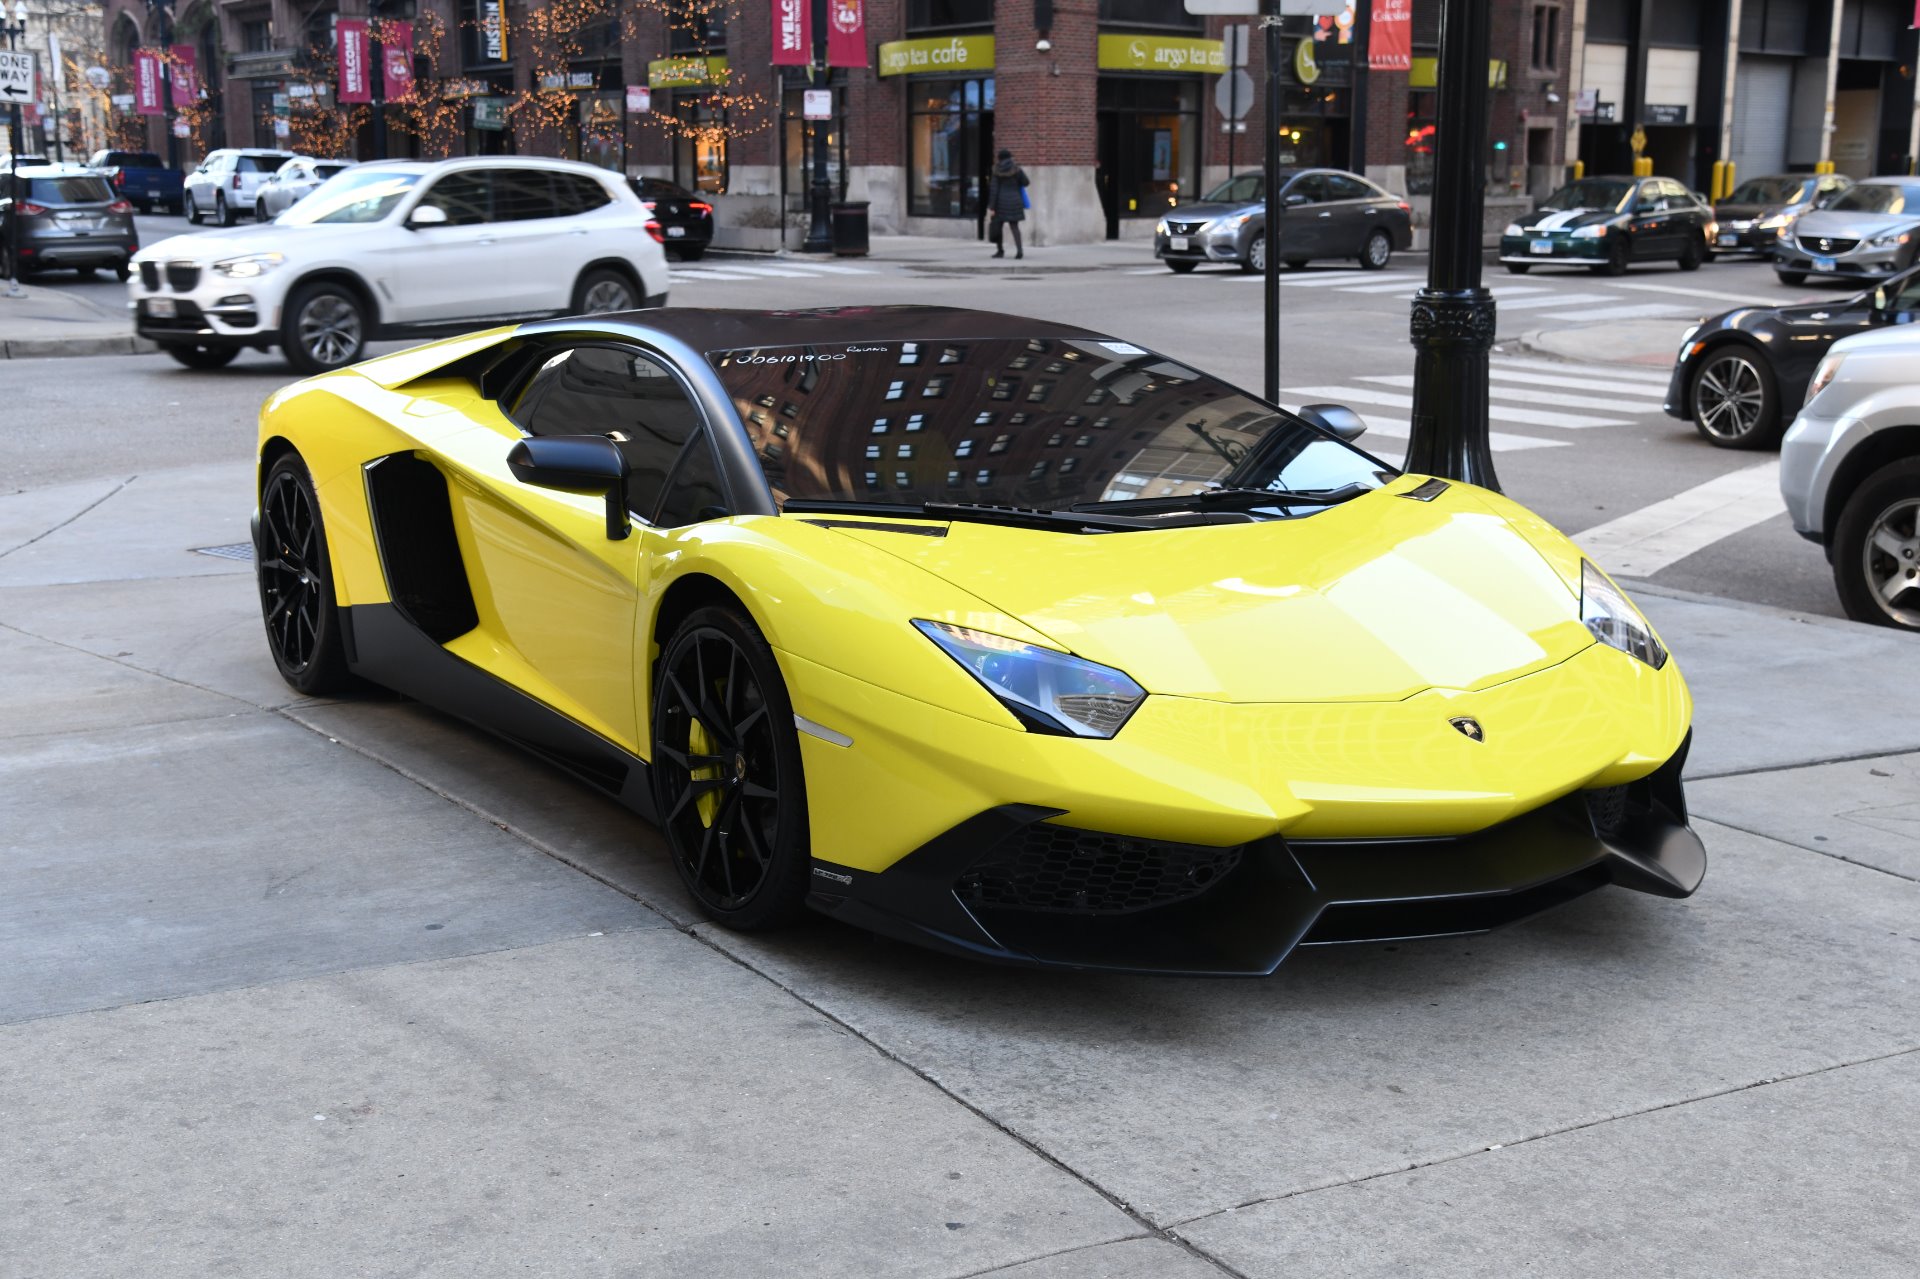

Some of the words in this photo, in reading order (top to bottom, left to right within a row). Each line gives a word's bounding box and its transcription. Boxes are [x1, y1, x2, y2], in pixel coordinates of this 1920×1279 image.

[486, 2, 501, 58] EINSTEIN
[0, 55, 29, 69] ONE
[344, 31, 357, 92] WELCOME
[932, 38, 967, 63] café
[1155, 48, 1188, 69] argo
[1190, 47, 1206, 64] tea
[0, 70, 29, 82] WAY
[141, 58, 152, 106] WELCOME
